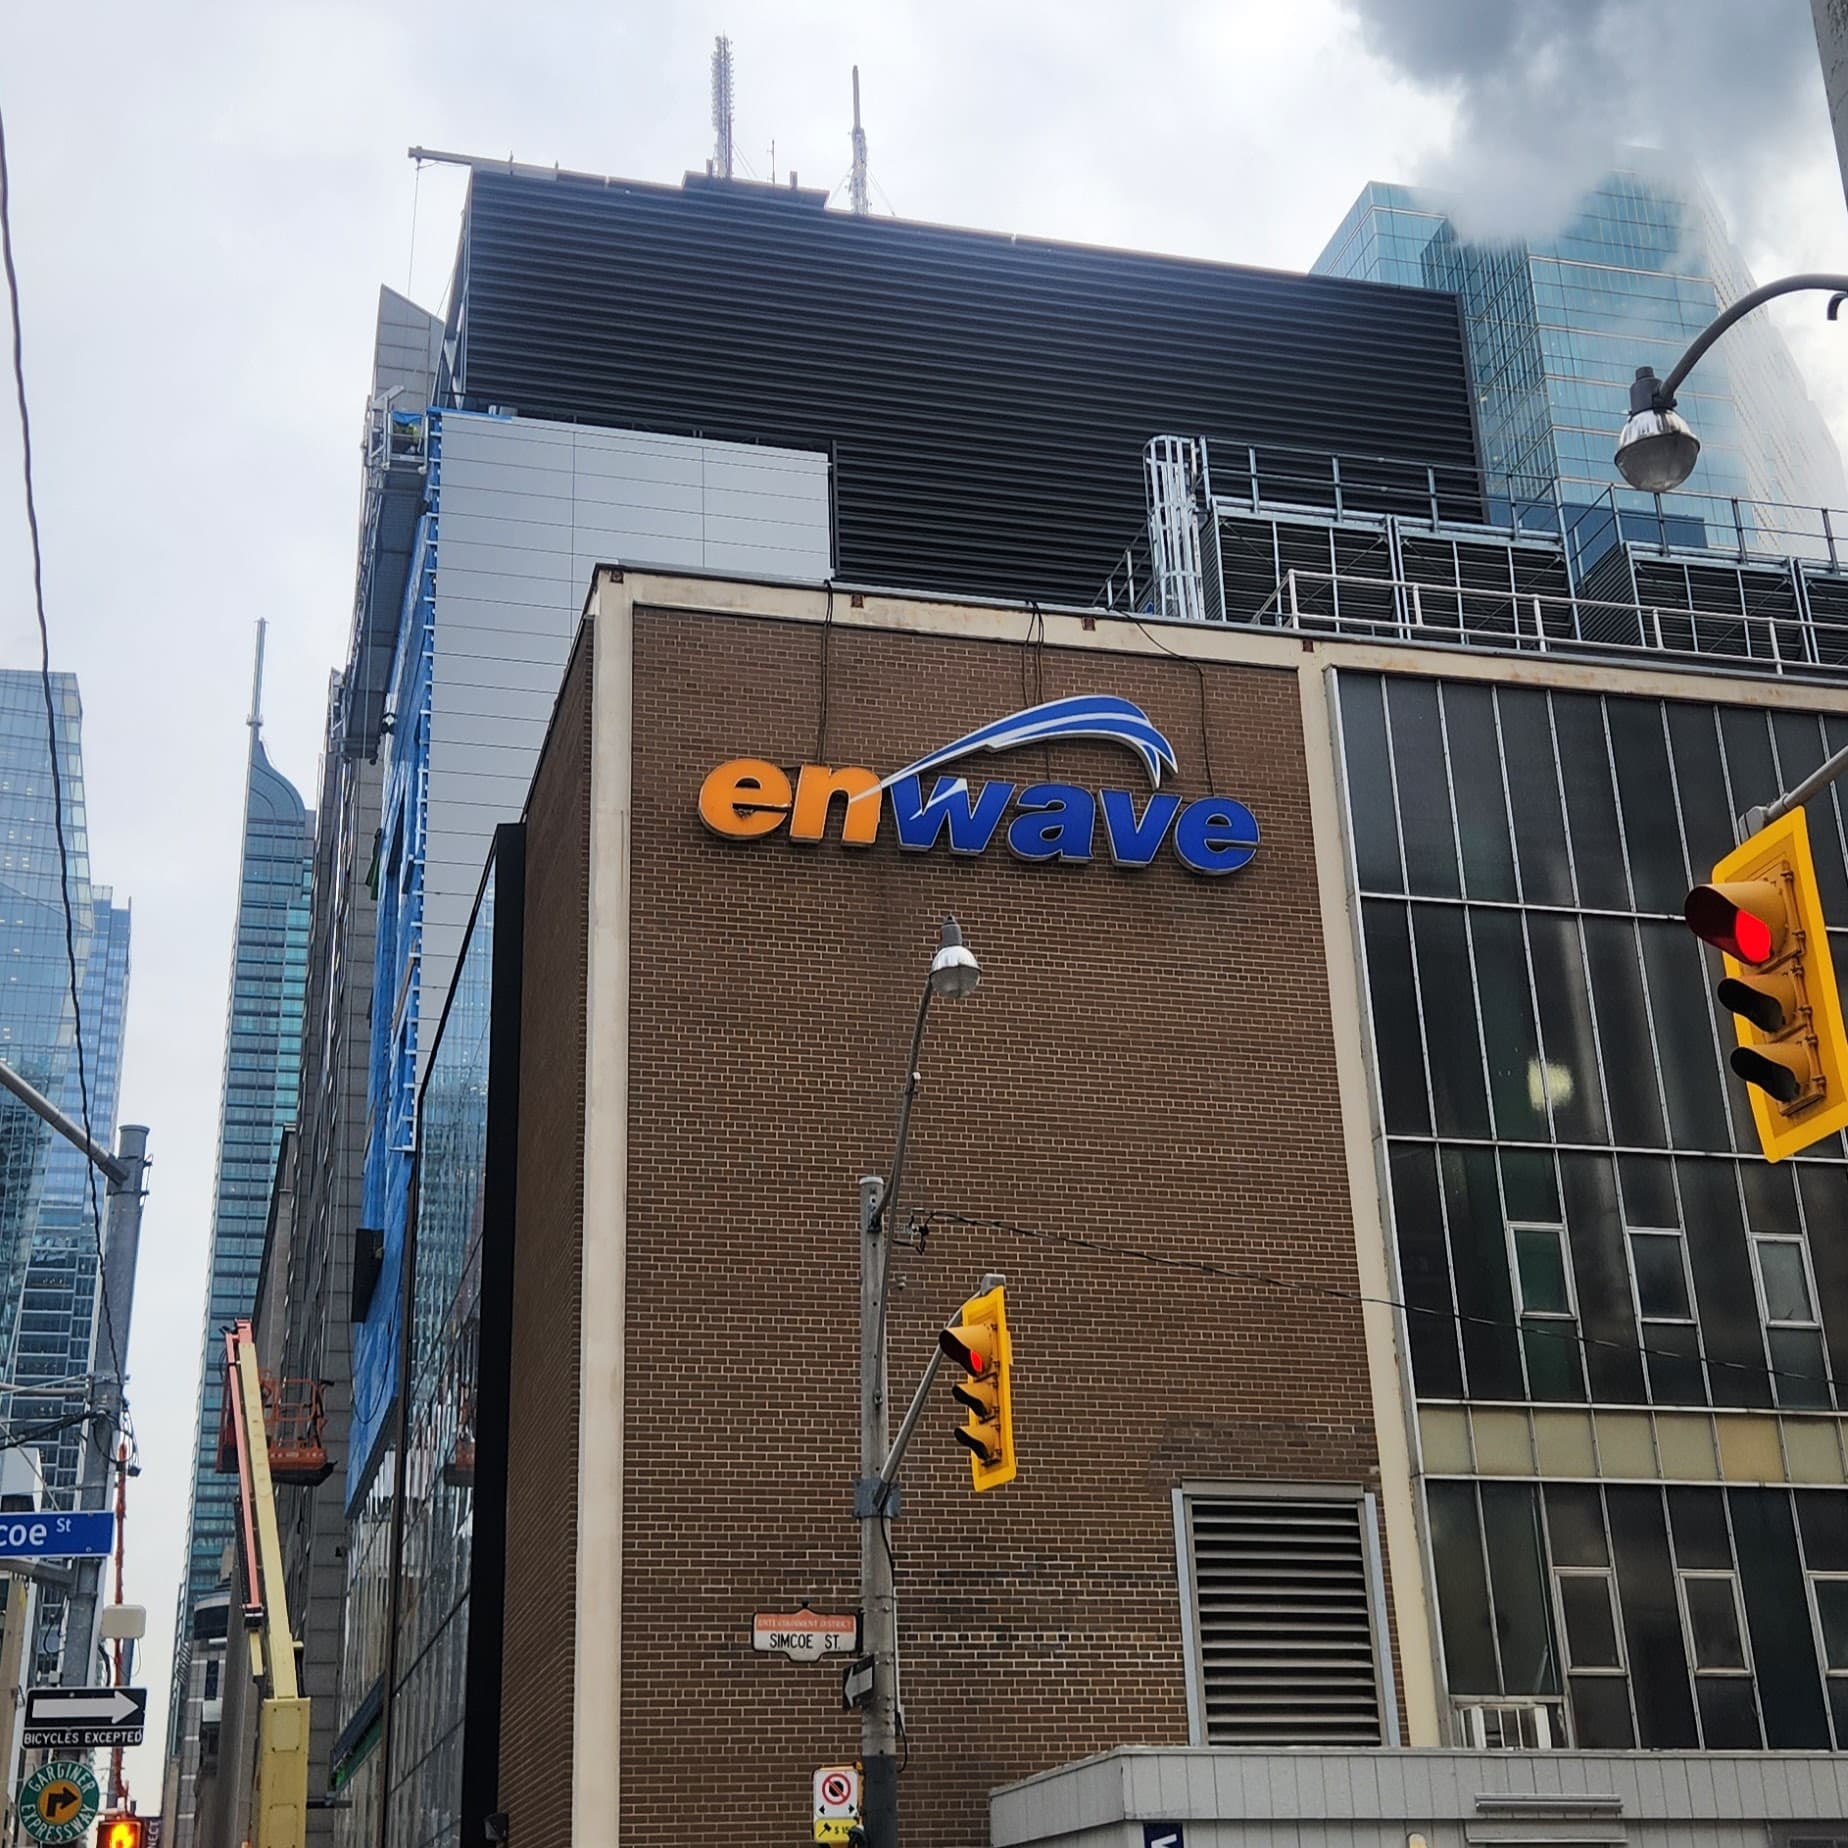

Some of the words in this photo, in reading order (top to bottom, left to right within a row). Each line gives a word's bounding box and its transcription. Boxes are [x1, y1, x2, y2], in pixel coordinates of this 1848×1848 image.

[698, 757, 1261, 876] enwave
[56, 1518, 72, 1532] St
[769, 1633, 813, 1648] SIMCOE
[24, 1732, 79, 1745] BICYCLES
[84, 1730, 142, 1743] EXCEPTED
[21, 1803, 96, 1842] EXPRESSWAY
